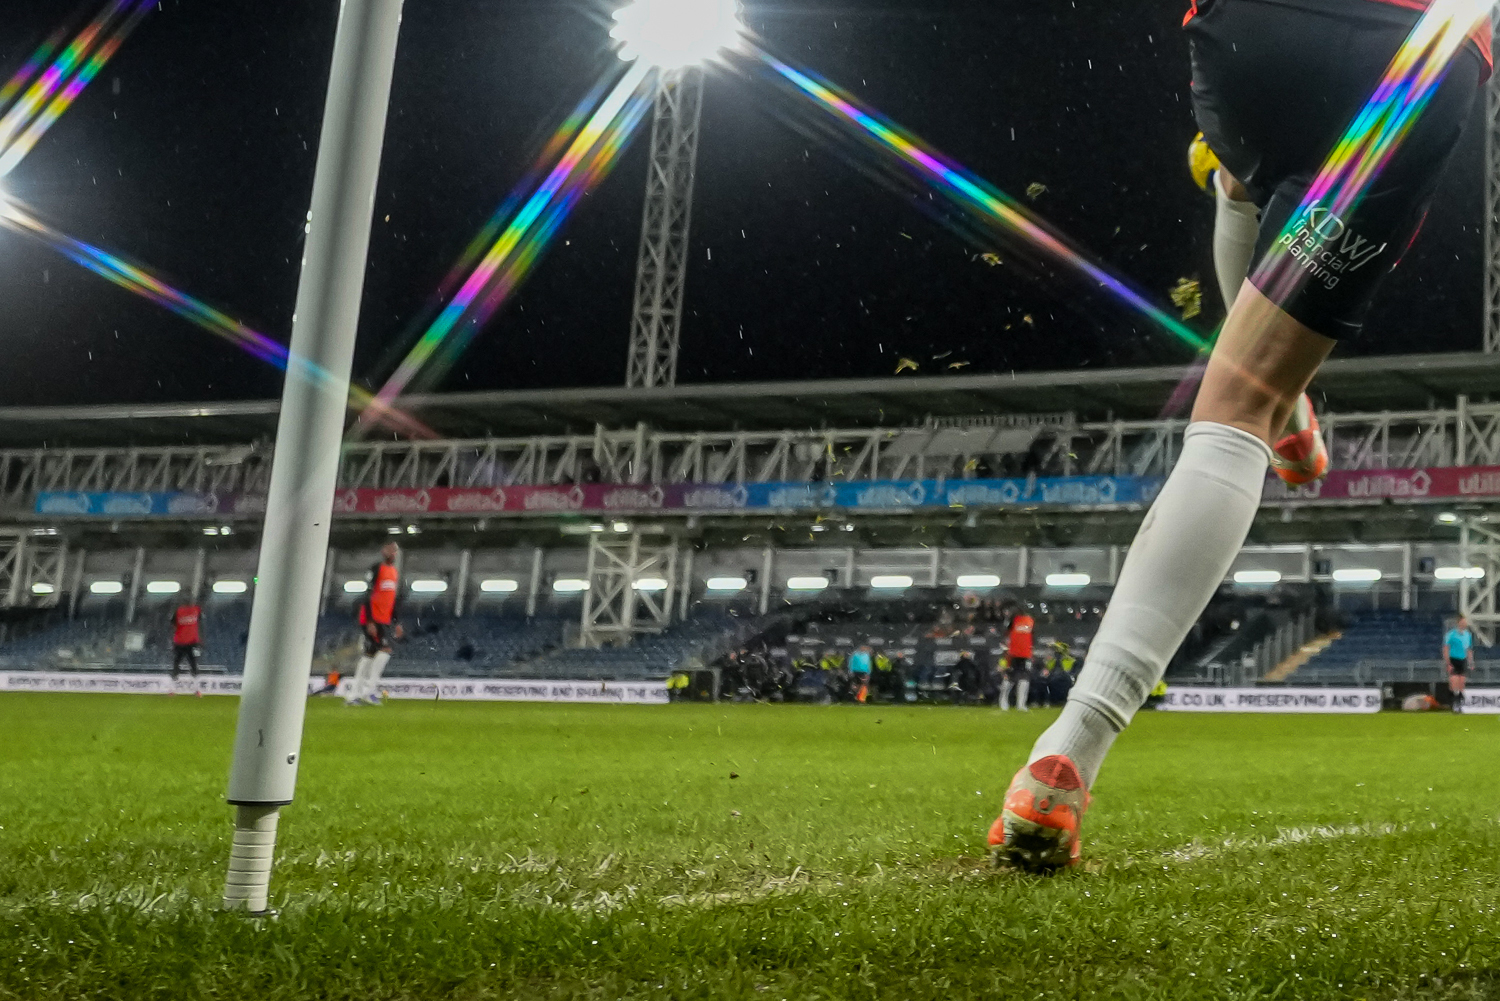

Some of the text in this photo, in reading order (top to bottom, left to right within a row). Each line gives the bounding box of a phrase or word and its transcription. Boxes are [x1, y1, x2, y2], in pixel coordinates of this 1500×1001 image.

[1279, 232, 1340, 291] planning
[1292, 217, 1351, 275] financial
[1238, 693, 1327, 708] PRESERVING
[1331, 693, 1361, 708] AND
